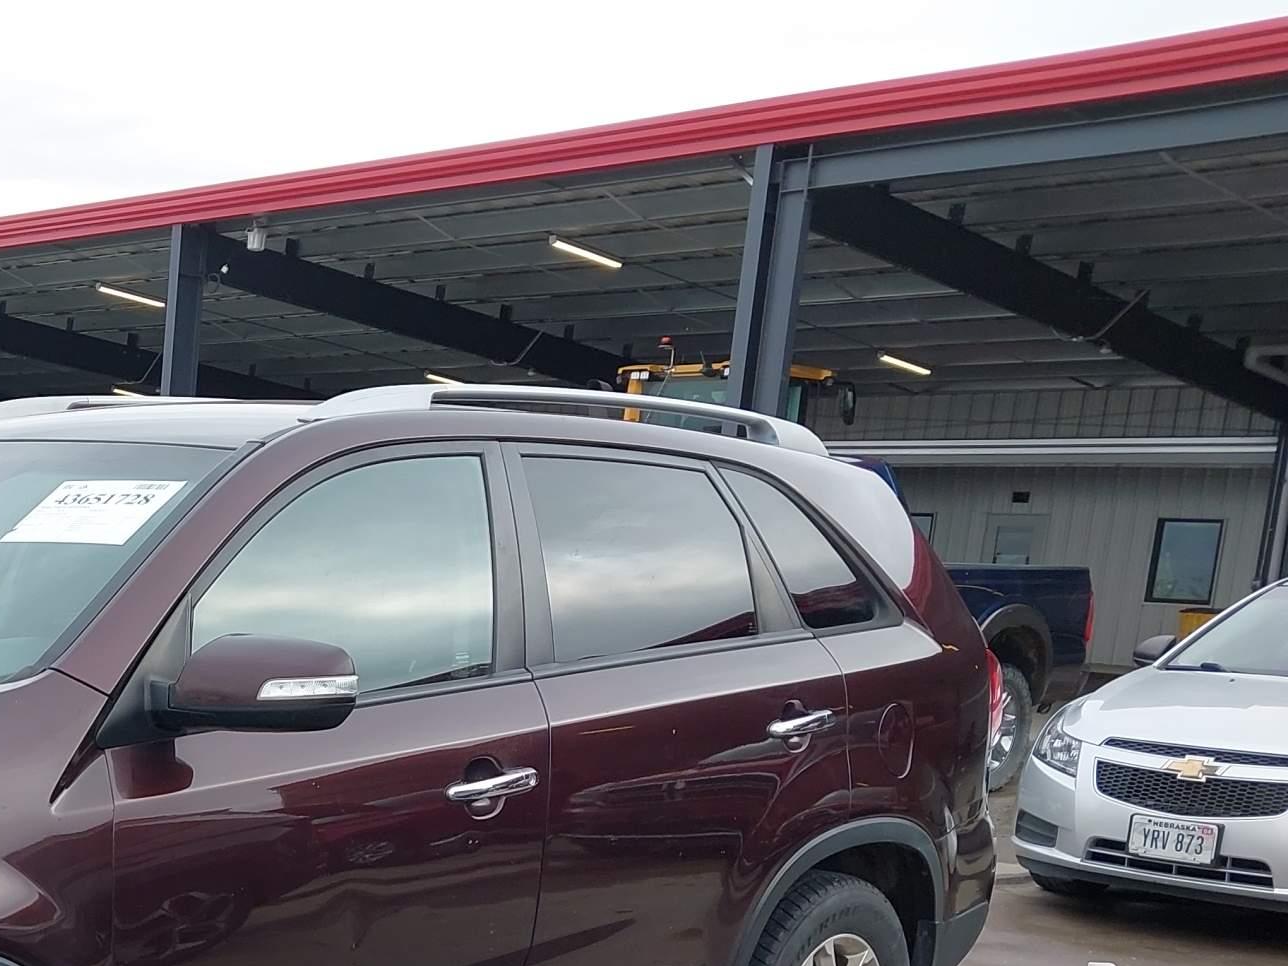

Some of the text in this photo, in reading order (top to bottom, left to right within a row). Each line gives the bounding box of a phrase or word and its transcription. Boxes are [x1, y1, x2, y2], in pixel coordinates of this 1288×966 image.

[54, 493, 156, 505] 43651728
[1152, 820, 1197, 832] NEBRASKA
[1143, 827, 1205, 855] YRV 873
